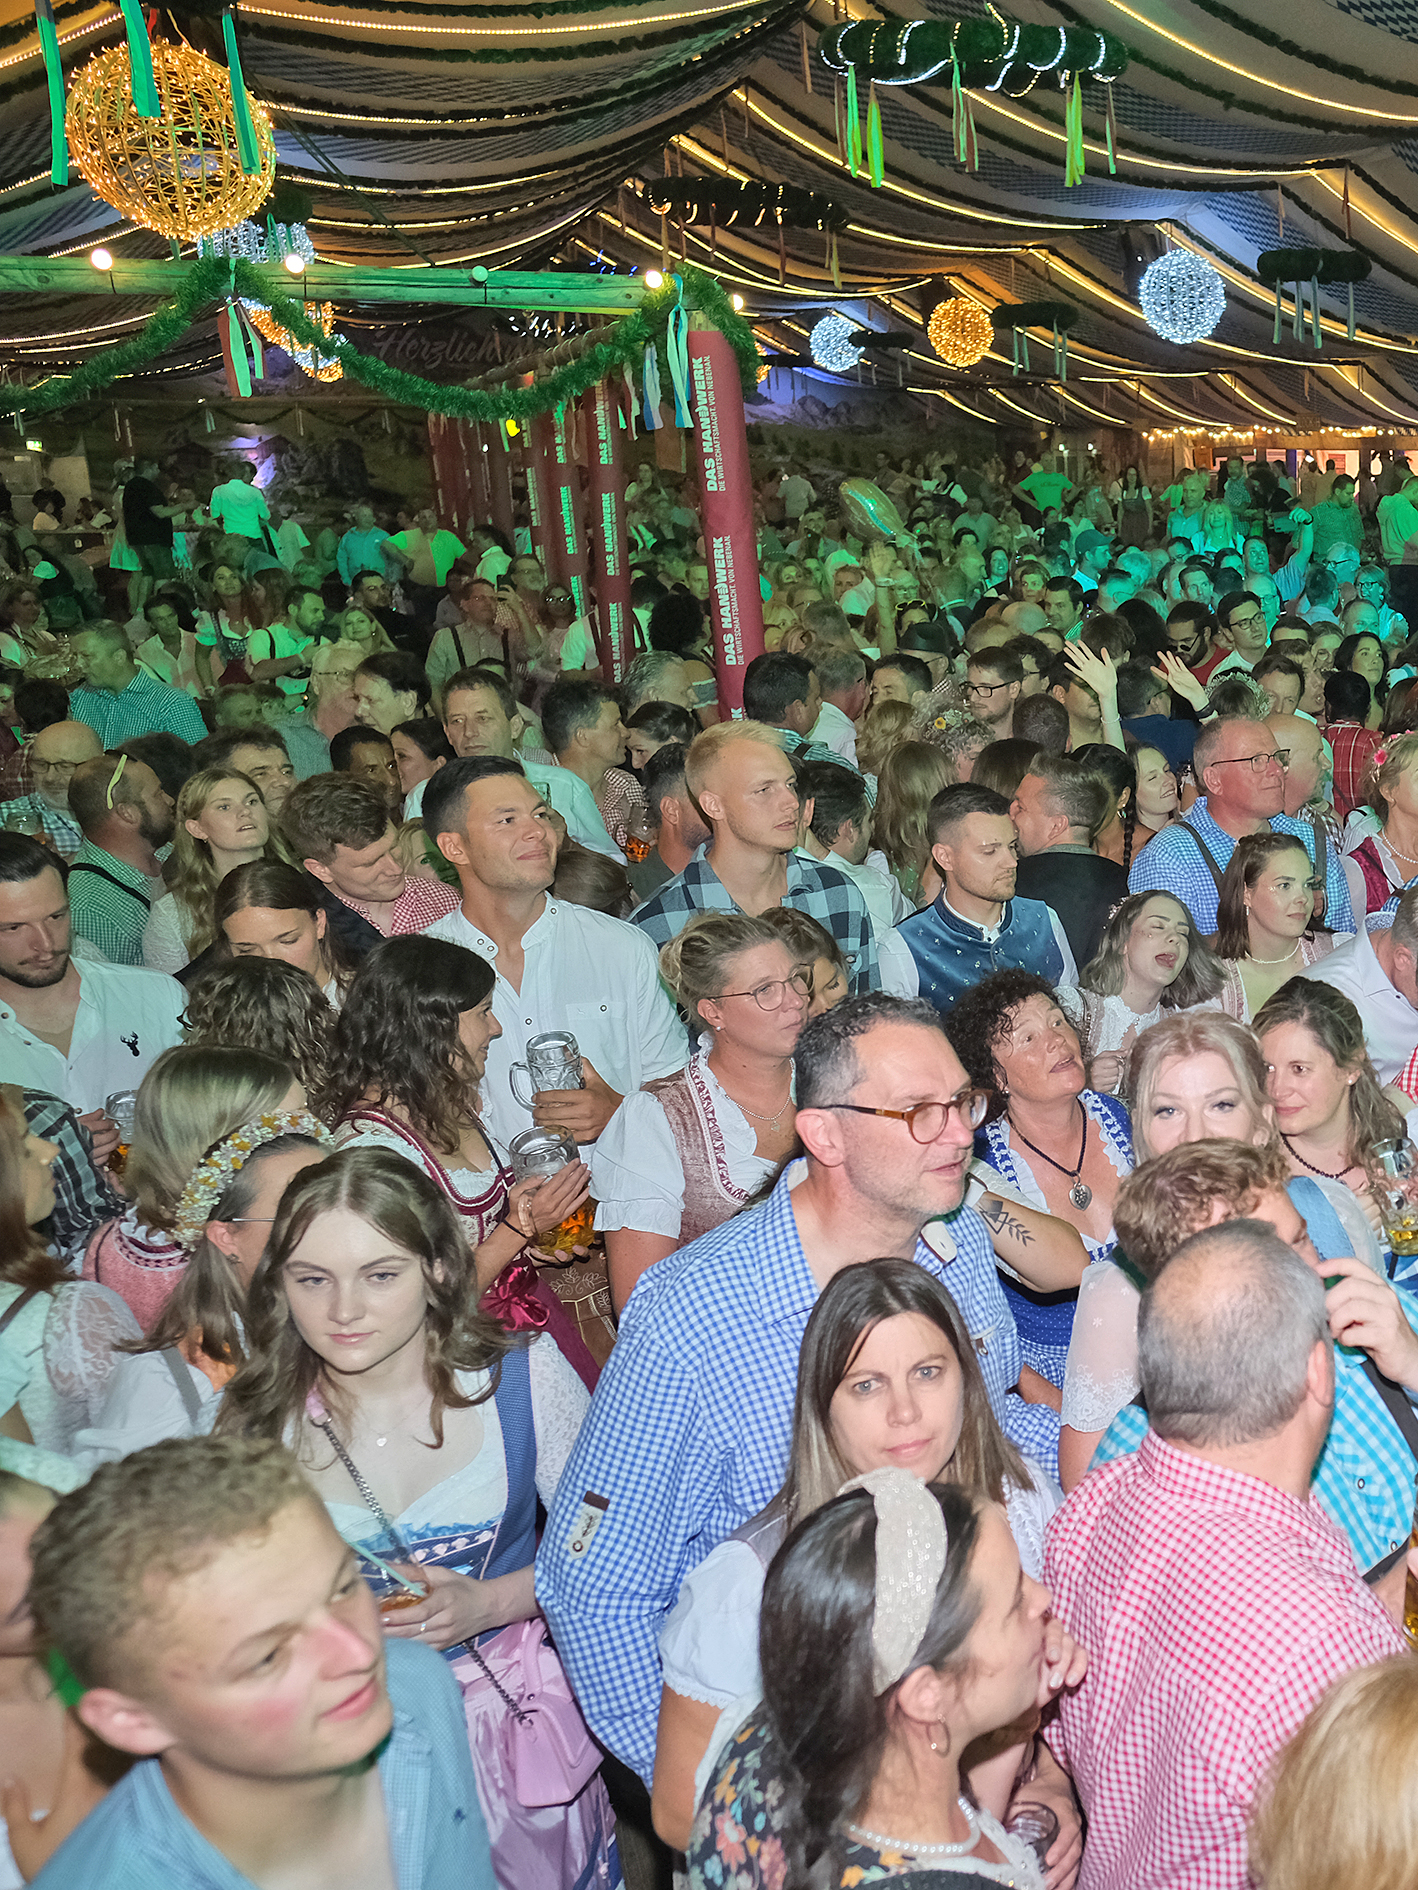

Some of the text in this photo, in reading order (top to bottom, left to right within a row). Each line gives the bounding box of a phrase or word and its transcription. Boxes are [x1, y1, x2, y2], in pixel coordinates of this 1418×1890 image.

[706, 390, 716, 406] VON
[693, 357, 719, 491] DAS HANDWERK
[599, 443, 609, 464] DAS
[717, 480, 727, 492] DIE
[601, 493, 615, 575] DAS HANDWERK
[727, 568, 736, 583] VON
[713, 536, 737, 665] DAS HANDWERK
[736, 655, 745, 666] DIE
[614, 662, 622, 683] DAS
